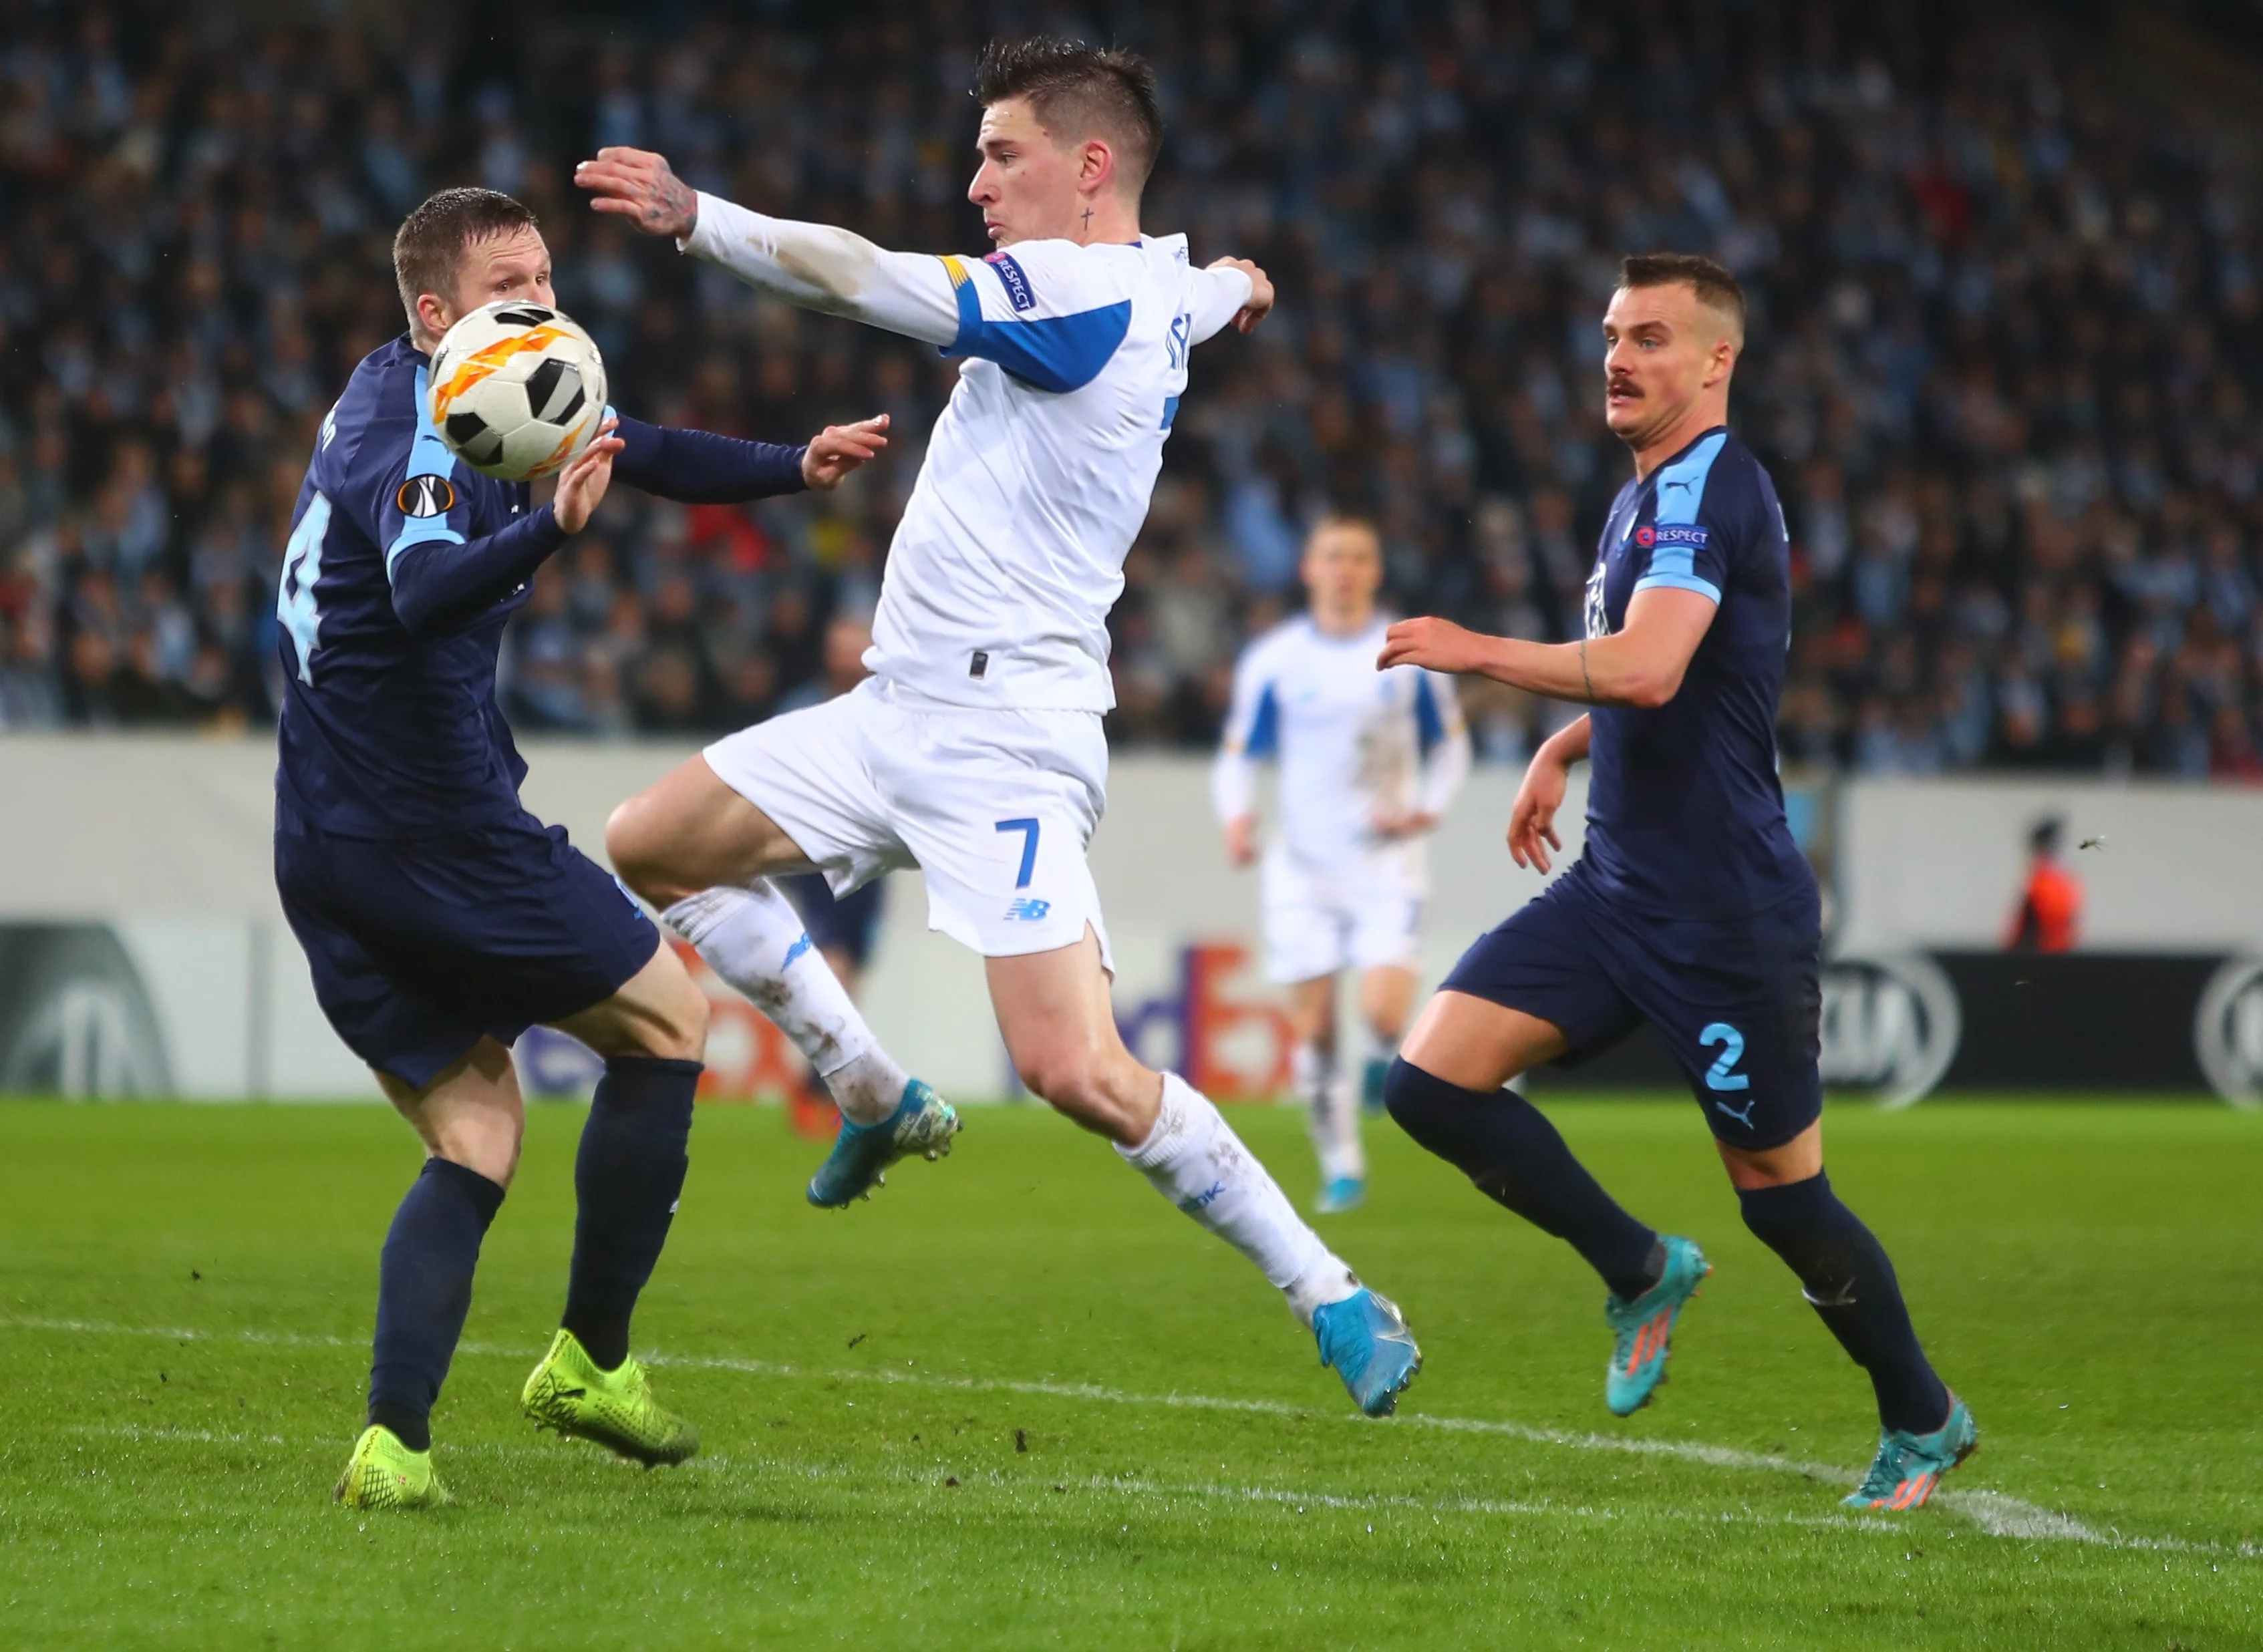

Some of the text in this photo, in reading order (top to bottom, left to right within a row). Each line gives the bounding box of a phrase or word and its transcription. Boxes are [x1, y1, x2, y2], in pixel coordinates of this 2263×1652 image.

[997, 260, 1031, 309] RESPECT
[1656, 529, 1708, 544] RESPECT
[994, 818, 1040, 890] 7
[1699, 1022, 1750, 1092] 2
